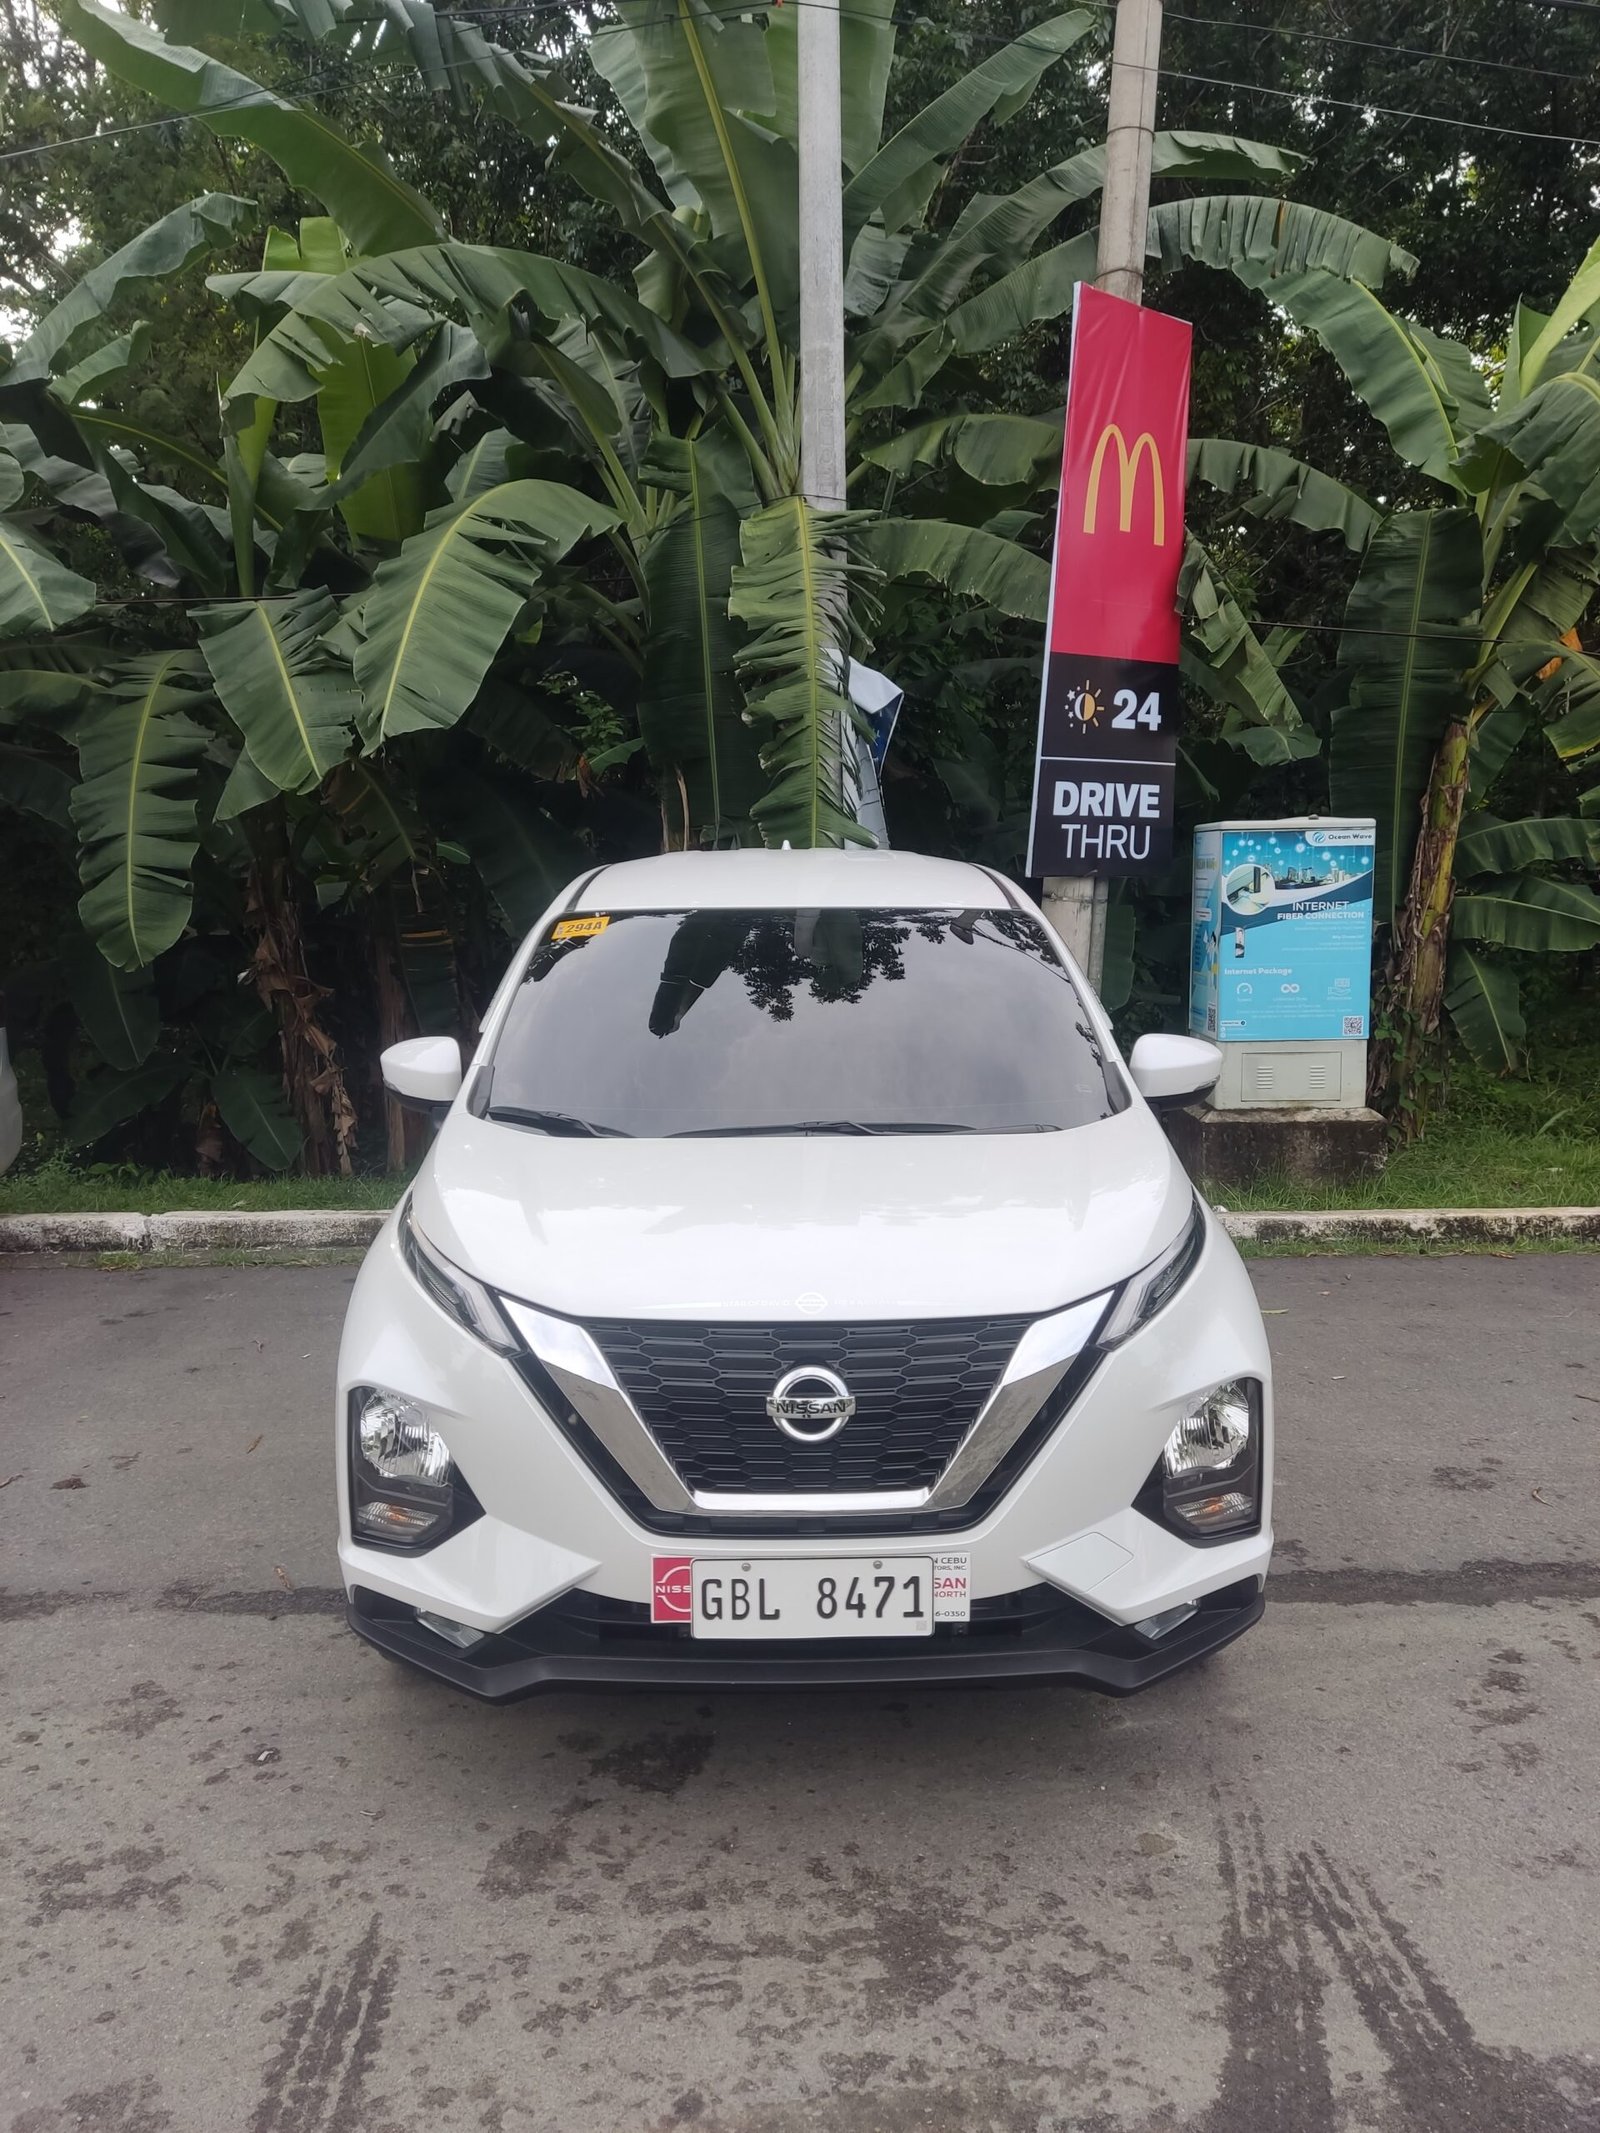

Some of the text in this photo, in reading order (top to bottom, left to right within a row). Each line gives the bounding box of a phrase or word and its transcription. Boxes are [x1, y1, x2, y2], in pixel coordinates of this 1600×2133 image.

[1111, 689, 1162, 731] 24
[1053, 781, 1160, 818] DRIVE
[1061, 824, 1151, 860] THRU
[1292, 901, 1350, 911] INTERNET
[1277, 911, 1365, 920] FIBER CONNECTION
[1224, 967, 1293, 976] Internet Package
[776, 1402, 846, 1414] NISSAN
[934, 1577, 967, 1590] SAN
[701, 1576, 924, 1620] GBL 8471
